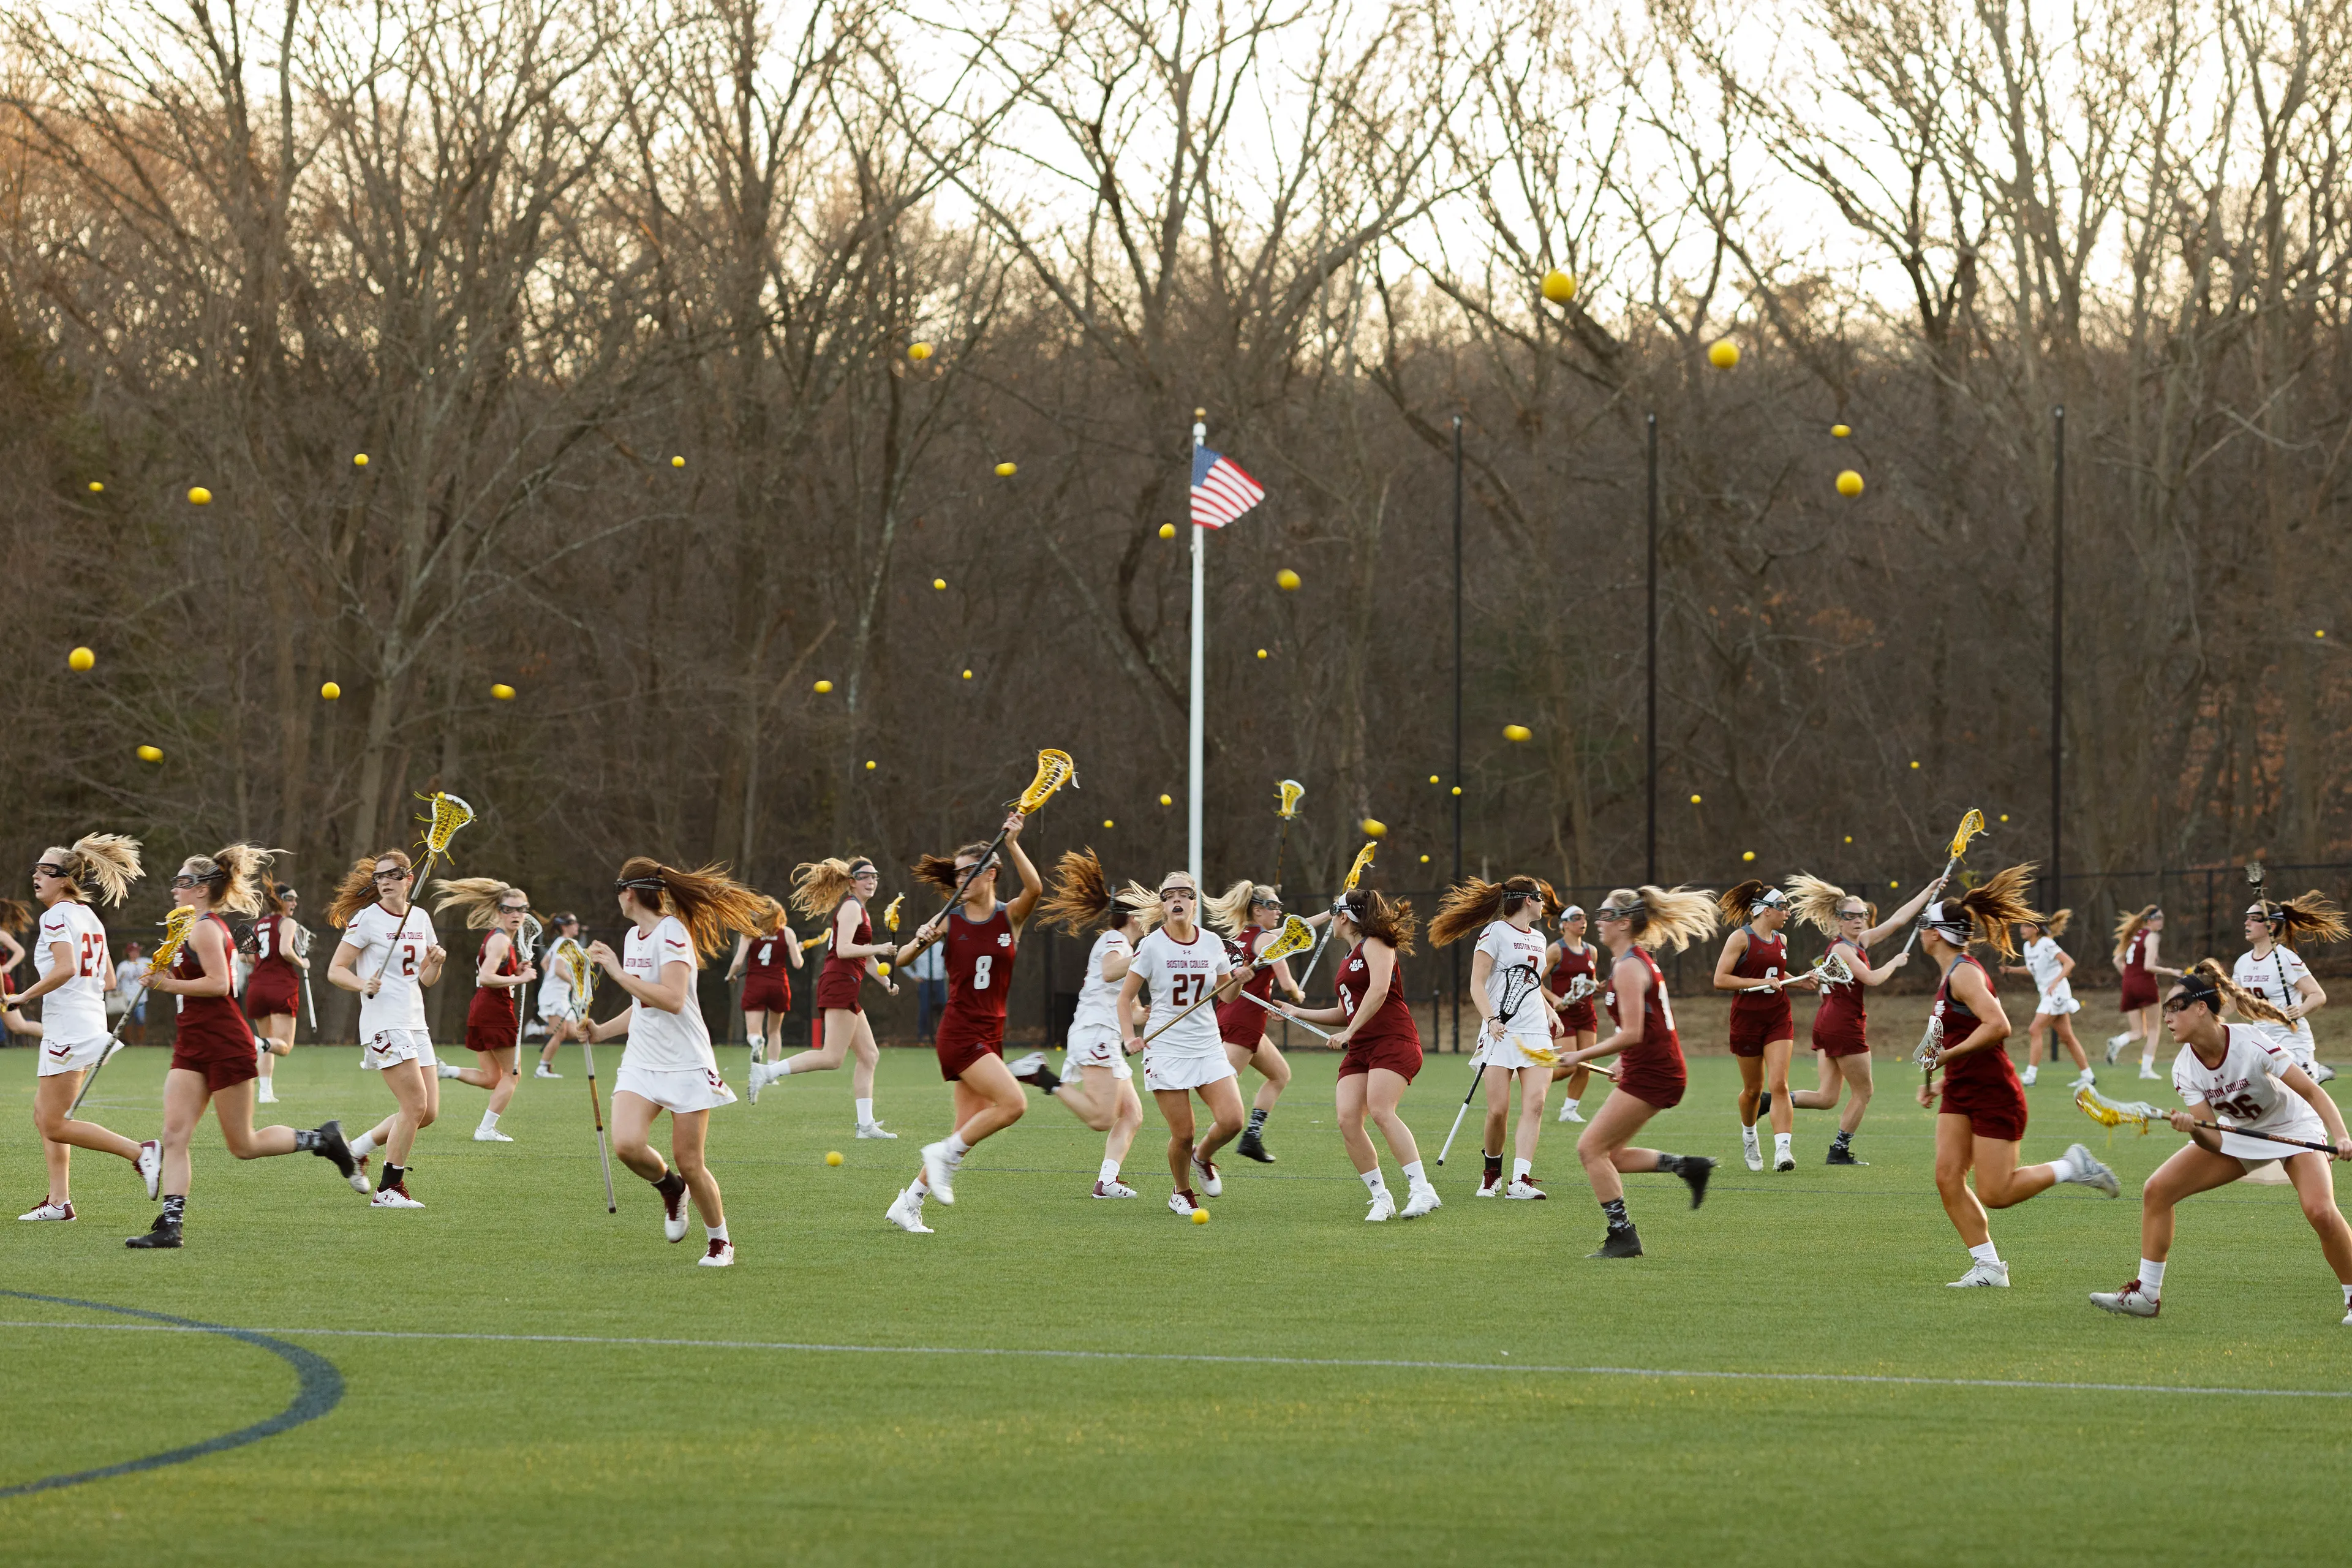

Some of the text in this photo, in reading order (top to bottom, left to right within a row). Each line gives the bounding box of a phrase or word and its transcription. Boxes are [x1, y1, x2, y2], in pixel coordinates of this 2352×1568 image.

[80, 933, 104, 978] 27
[402, 944, 416, 976] 2
[758, 943, 772, 966] 4
[1513, 942, 1531, 951] BOSTON
[973, 956, 992, 990] 8
[1172, 974, 1205, 1006] 27
[1339, 983, 1354, 1016] 2
[2225, 1077, 2251, 1094] COLLEGE
[2214, 1094, 2263, 1120] 26
